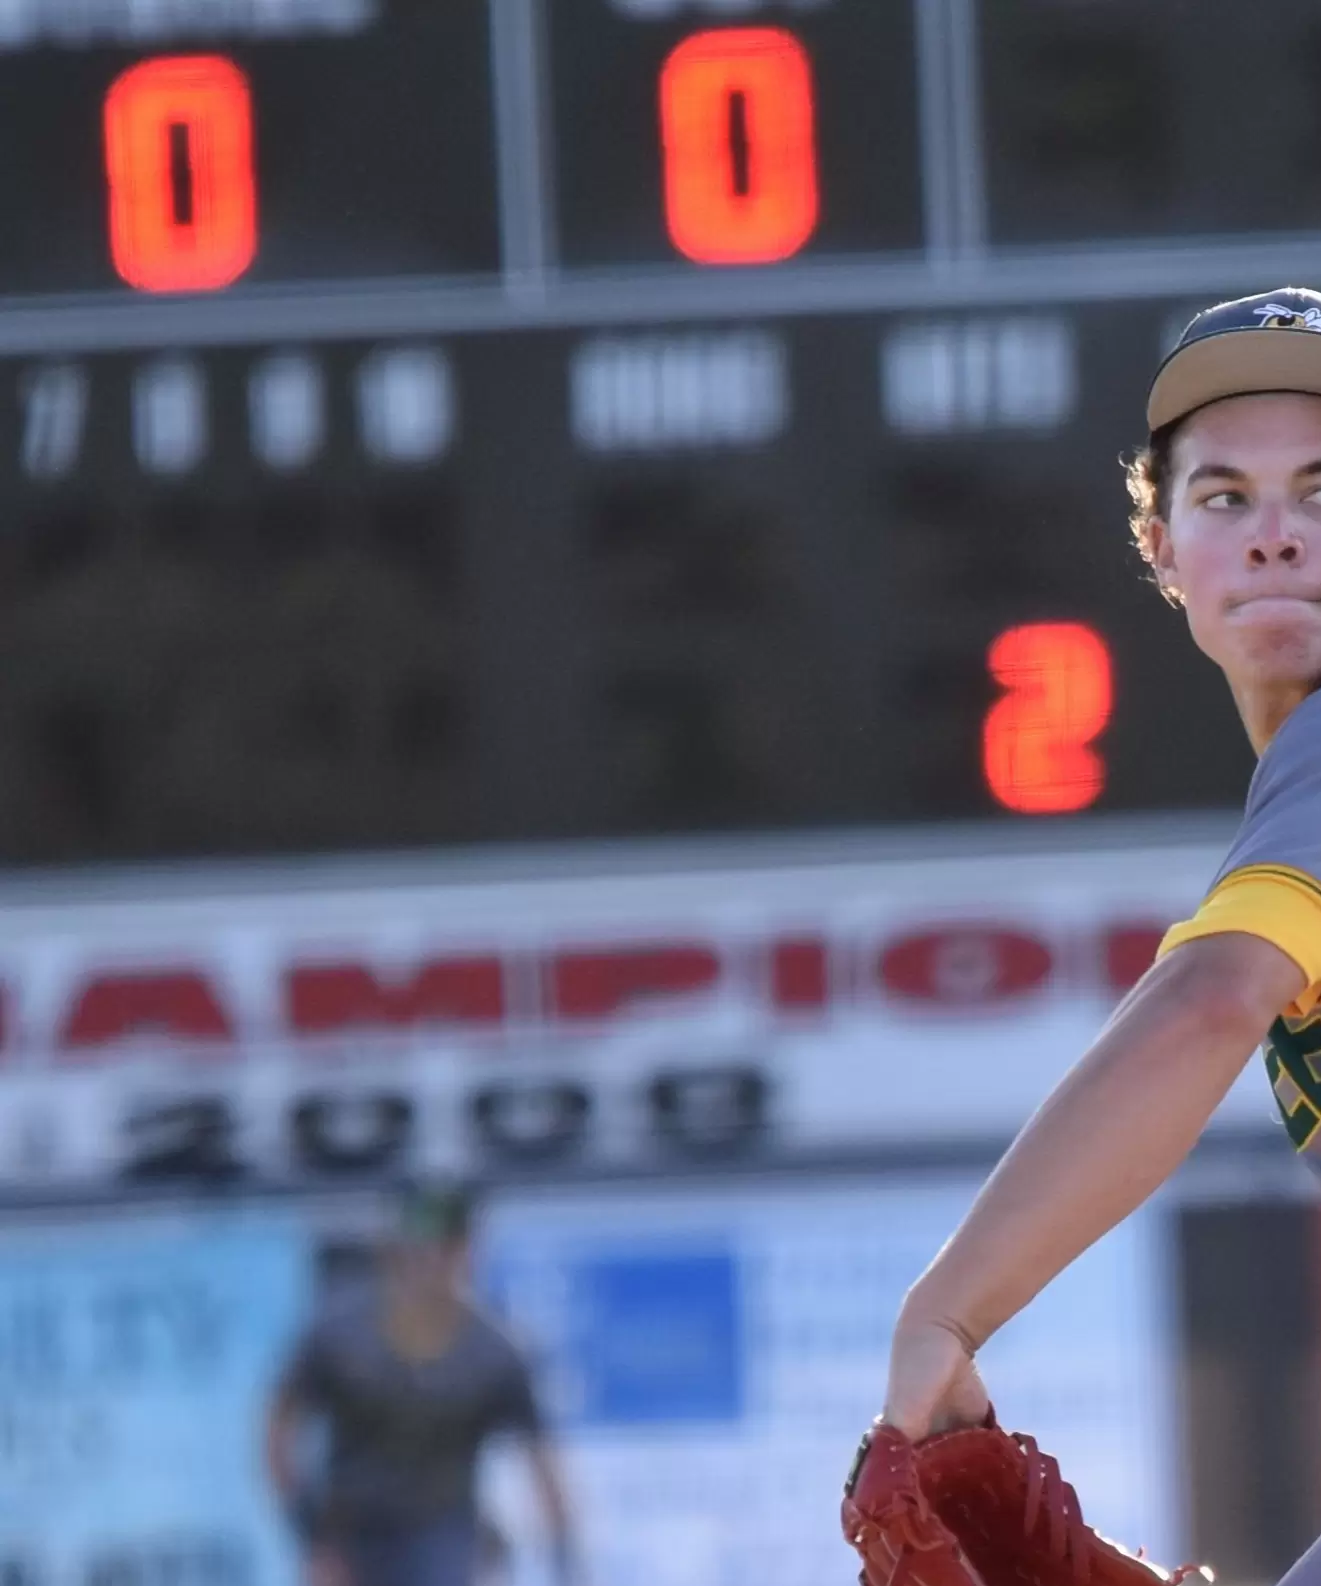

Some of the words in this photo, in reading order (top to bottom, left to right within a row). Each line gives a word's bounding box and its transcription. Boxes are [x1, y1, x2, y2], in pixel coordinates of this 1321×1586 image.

[103, 52, 258, 294] 0
[659, 26, 819, 266] 0
[0, 922, 1172, 1062] AMPIO
